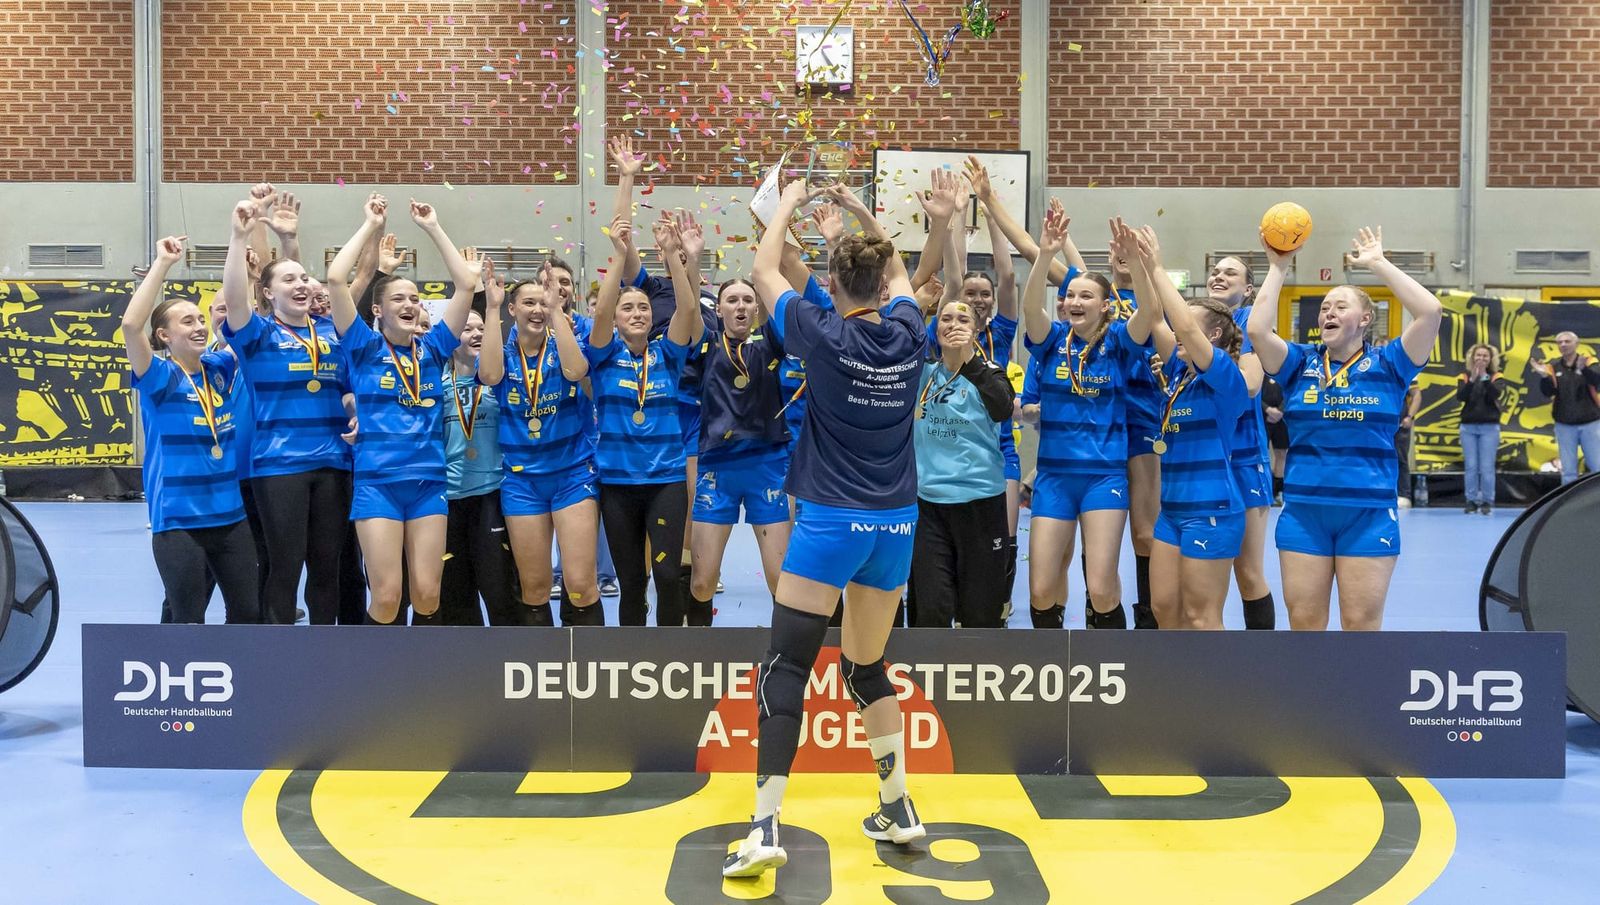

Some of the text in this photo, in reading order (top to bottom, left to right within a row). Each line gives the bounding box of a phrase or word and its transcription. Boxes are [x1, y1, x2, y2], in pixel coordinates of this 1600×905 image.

[839, 356, 918, 373] DEUTSCHE MEISTERSCHAFT
[852, 380, 873, 389] FINAL
[866, 374, 900, 382] A-JUGEND
[848, 395, 905, 408] Beste Torschützin
[1323, 394, 1379, 406] Sparkasse
[929, 414, 970, 426] Sparkasse
[1323, 408, 1364, 421] Leipzig
[927, 426, 957, 439] Leipzig
[114, 661, 234, 702] DHB
[504, 661, 1127, 705] DEUTSCHE MSTER2025
[1399, 669, 1524, 712] DHB
[123, 707, 233, 717] Deutscher Handballbund
[1410, 716, 1522, 727] Deutscher Handballbund
